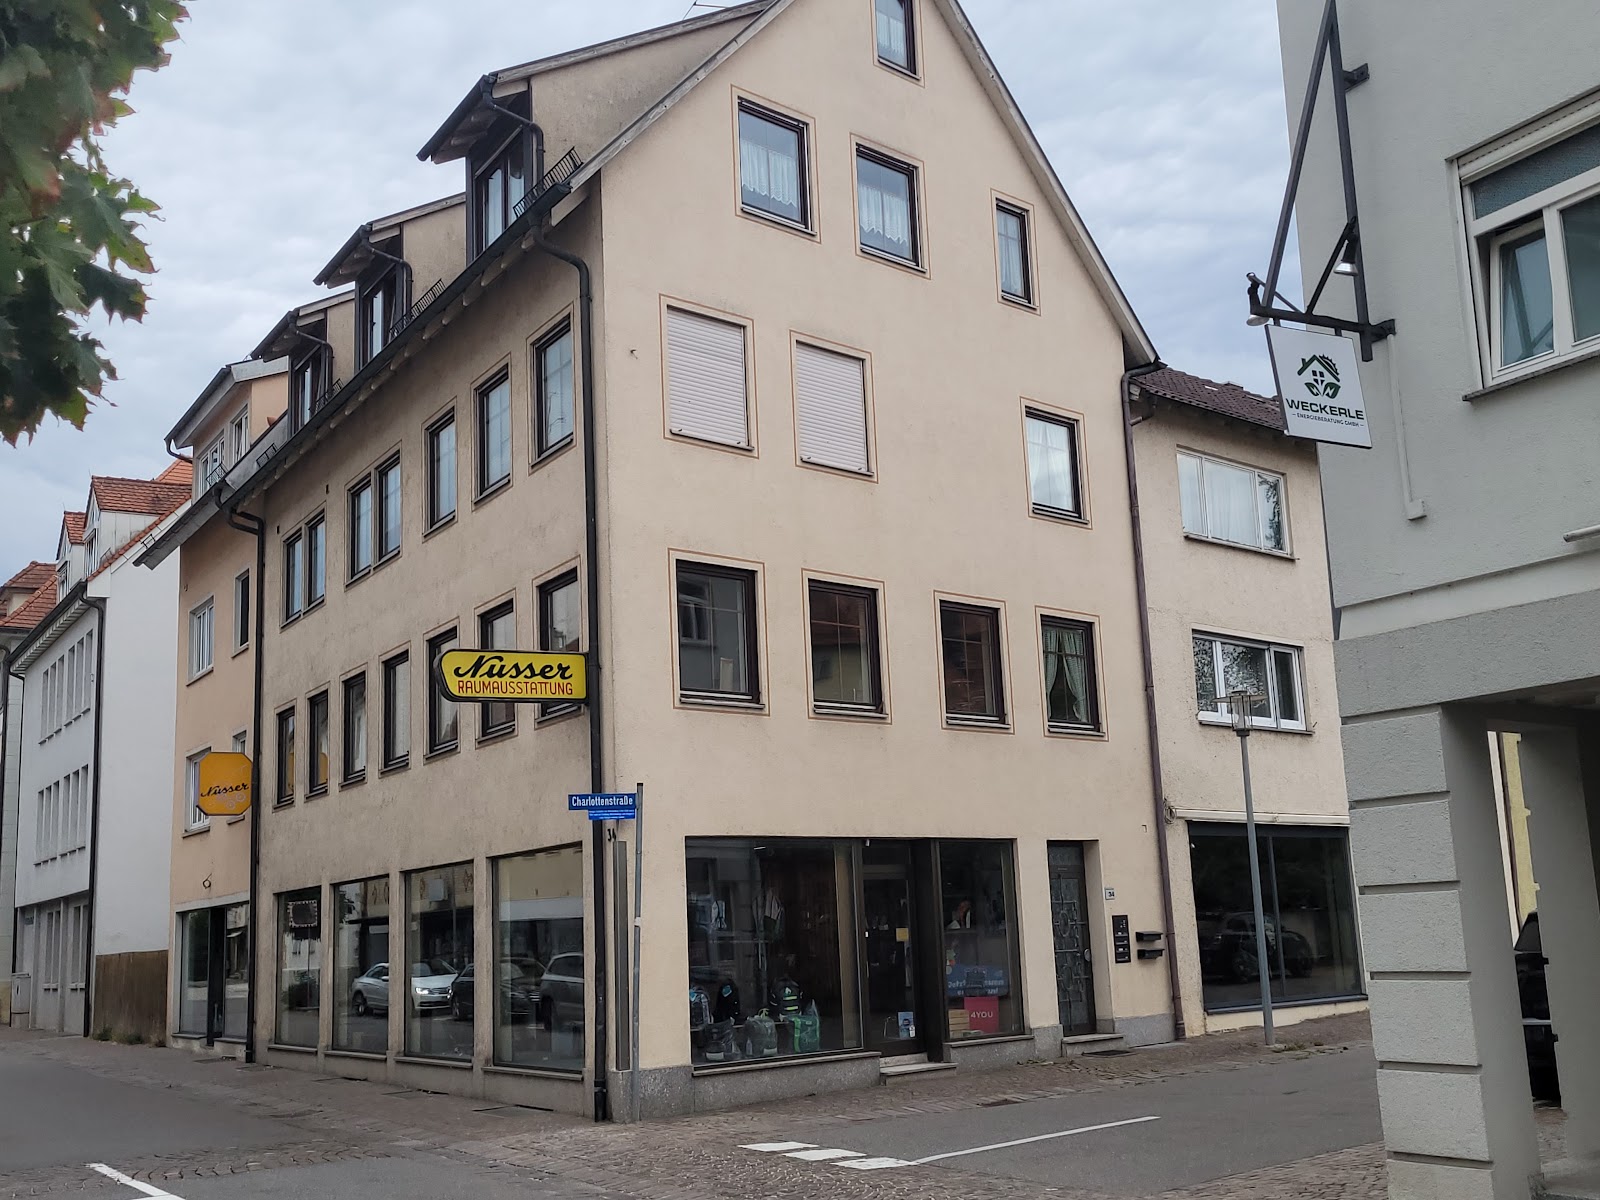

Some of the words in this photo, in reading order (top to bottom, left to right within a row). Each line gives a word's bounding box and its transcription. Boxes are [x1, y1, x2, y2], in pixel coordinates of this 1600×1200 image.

[1286, 397, 1364, 420] WECKERLE
[453, 655, 573, 680] Nusser
[458, 680, 573, 695] RAUMAUSSTATTUNG
[200, 782, 249, 797] Nusser
[571, 795, 633, 807] Charlottenstraße
[607, 828, 617, 842] 34
